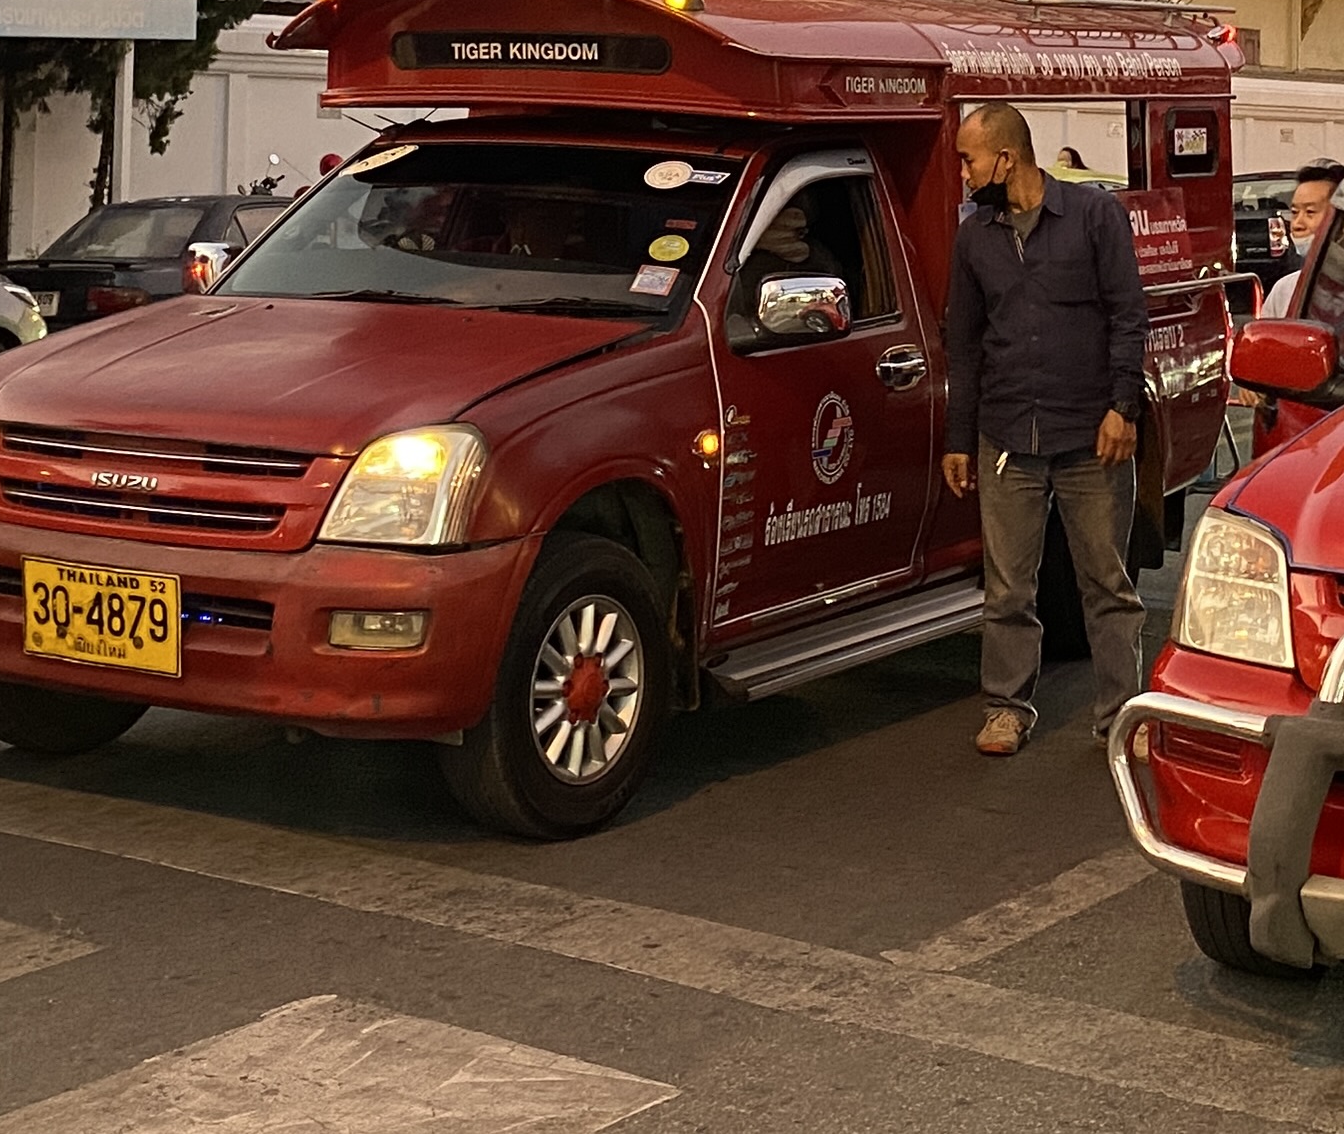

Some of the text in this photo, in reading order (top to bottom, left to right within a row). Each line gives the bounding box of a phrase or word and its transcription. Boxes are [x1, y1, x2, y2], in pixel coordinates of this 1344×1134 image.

[451, 42, 600, 61] TIGER KINGDOM
[1037, 52, 1054, 76] 30
[1102, 54, 1118, 77] 30
[1115, 51, 1183, 77] Baht/Person
[845, 76, 927, 94] TIGER KINGDOM
[91, 472, 158, 491] ISUZU
[57, 568, 167, 594] THAILAND 52
[33, 582, 169, 643] 30-4879
